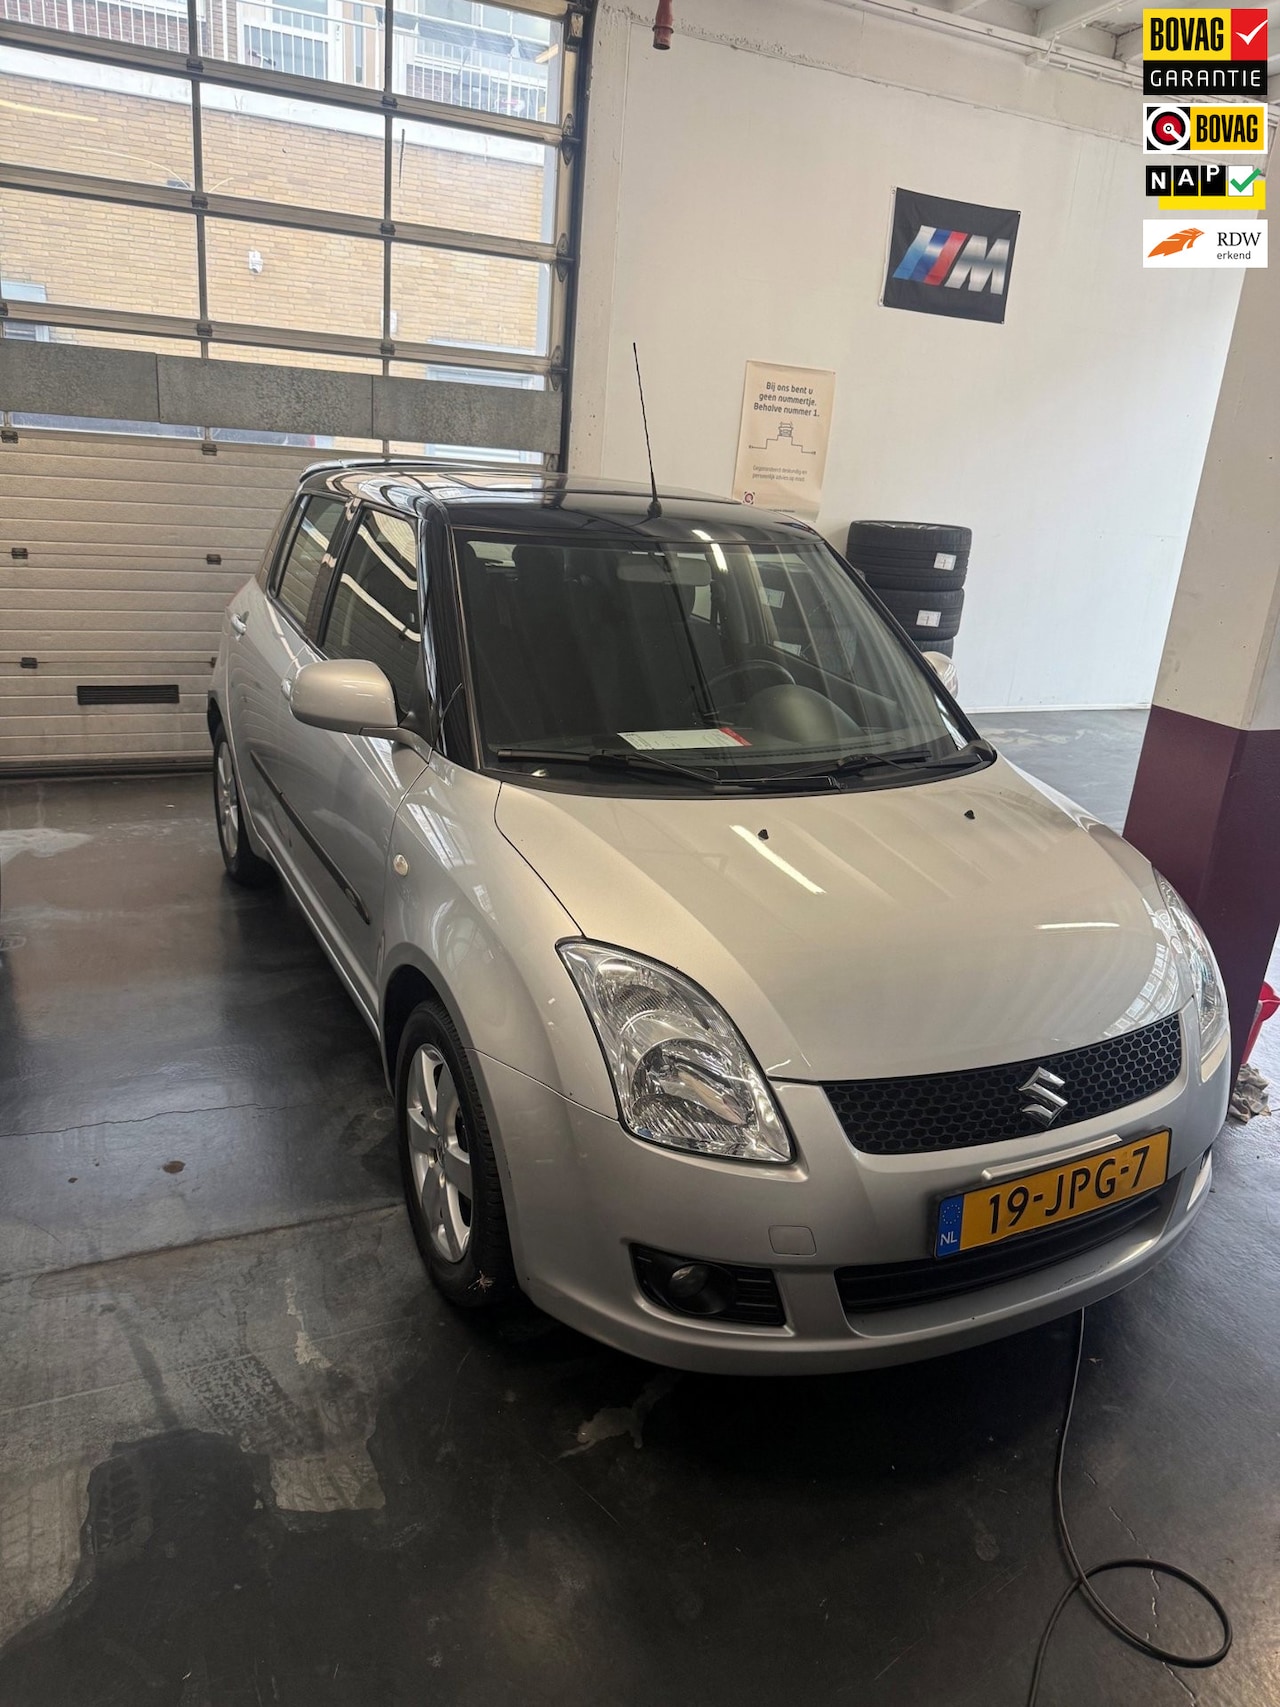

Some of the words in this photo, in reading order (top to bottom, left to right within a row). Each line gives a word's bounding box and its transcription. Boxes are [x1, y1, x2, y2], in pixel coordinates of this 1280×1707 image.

[766, 381, 776, 392] Bij
[777, 384, 789, 392] ons
[791, 385, 807, 394] bent
[759, 393, 776, 401] geen
[778, 395, 817, 407] nummertje.
[753, 402, 782, 412] Behalve
[784, 407, 812, 416] nummer
[989, 1145, 1150, 1234] 19-JPG-7
[939, 1231, 958, 1247] NL
